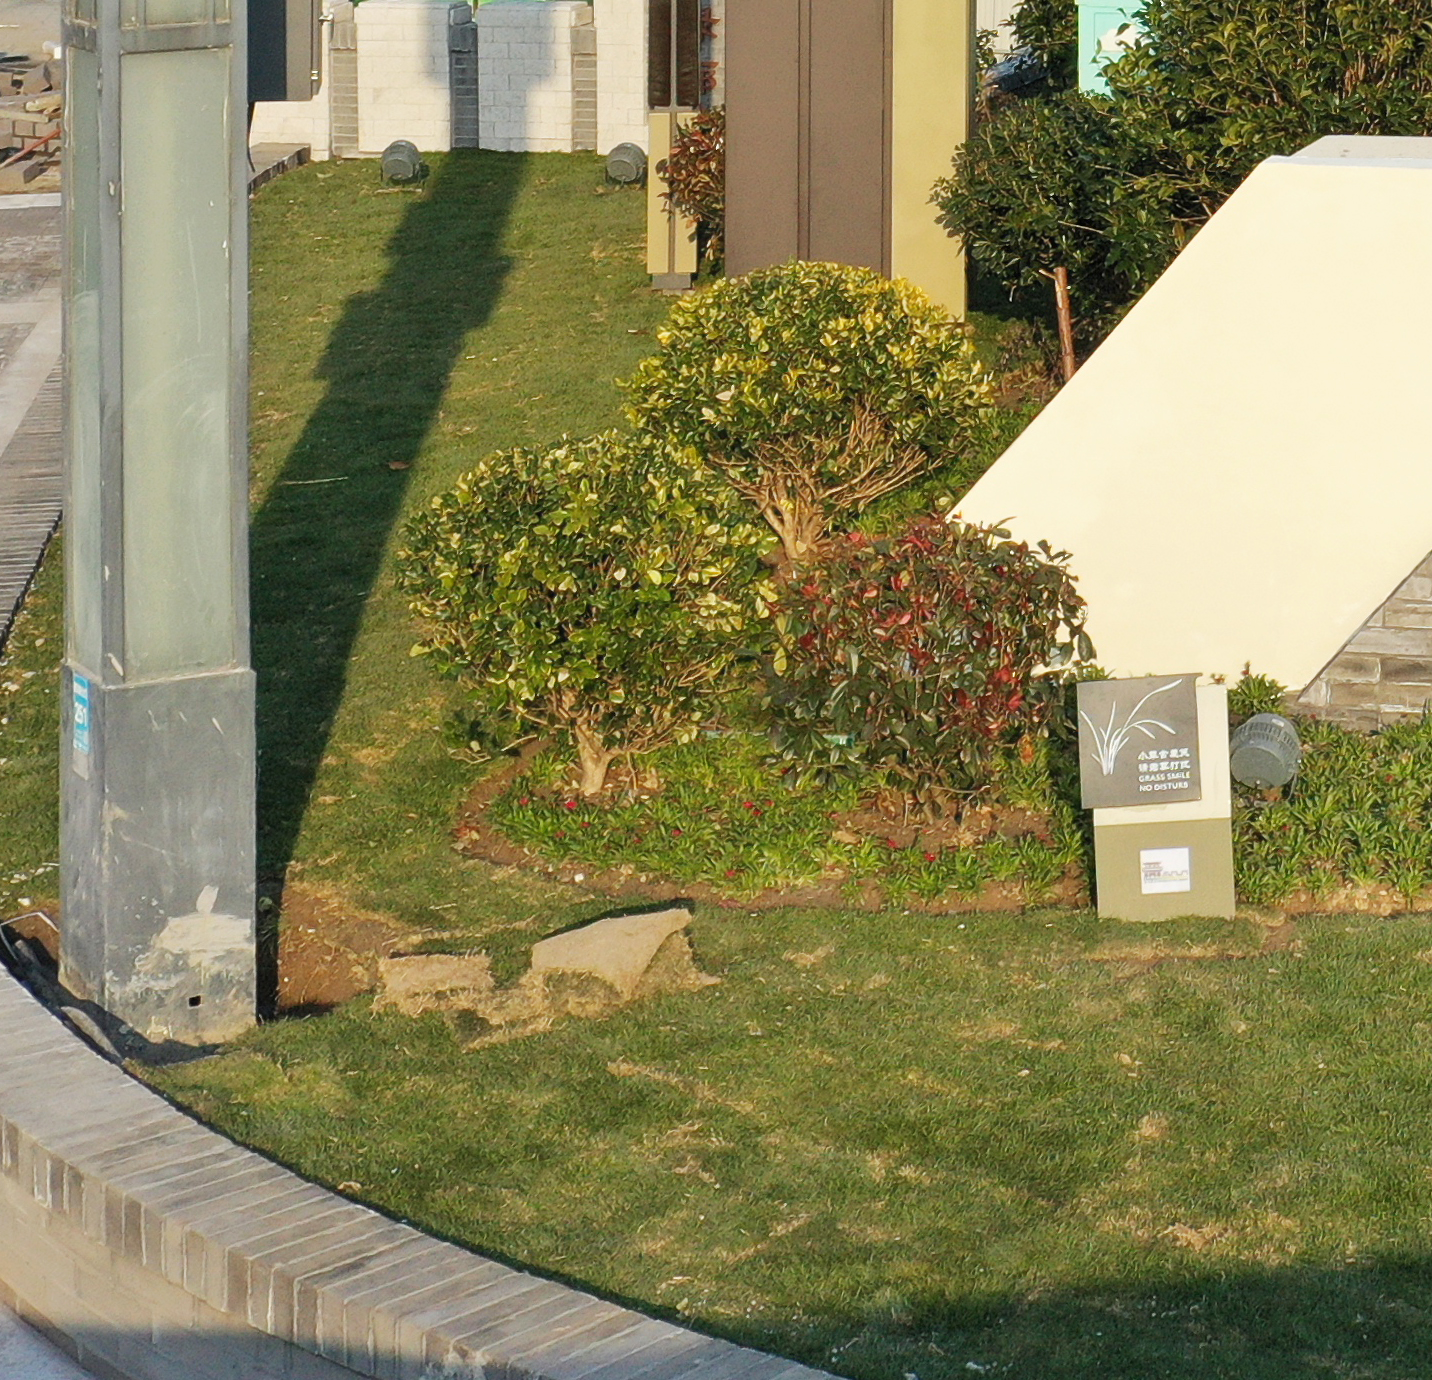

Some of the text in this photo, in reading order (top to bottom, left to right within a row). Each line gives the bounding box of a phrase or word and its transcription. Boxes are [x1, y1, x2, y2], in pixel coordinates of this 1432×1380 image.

[1138, 773, 1166, 782] GRASS
[1139, 781, 1189, 792] NO DISTURB
